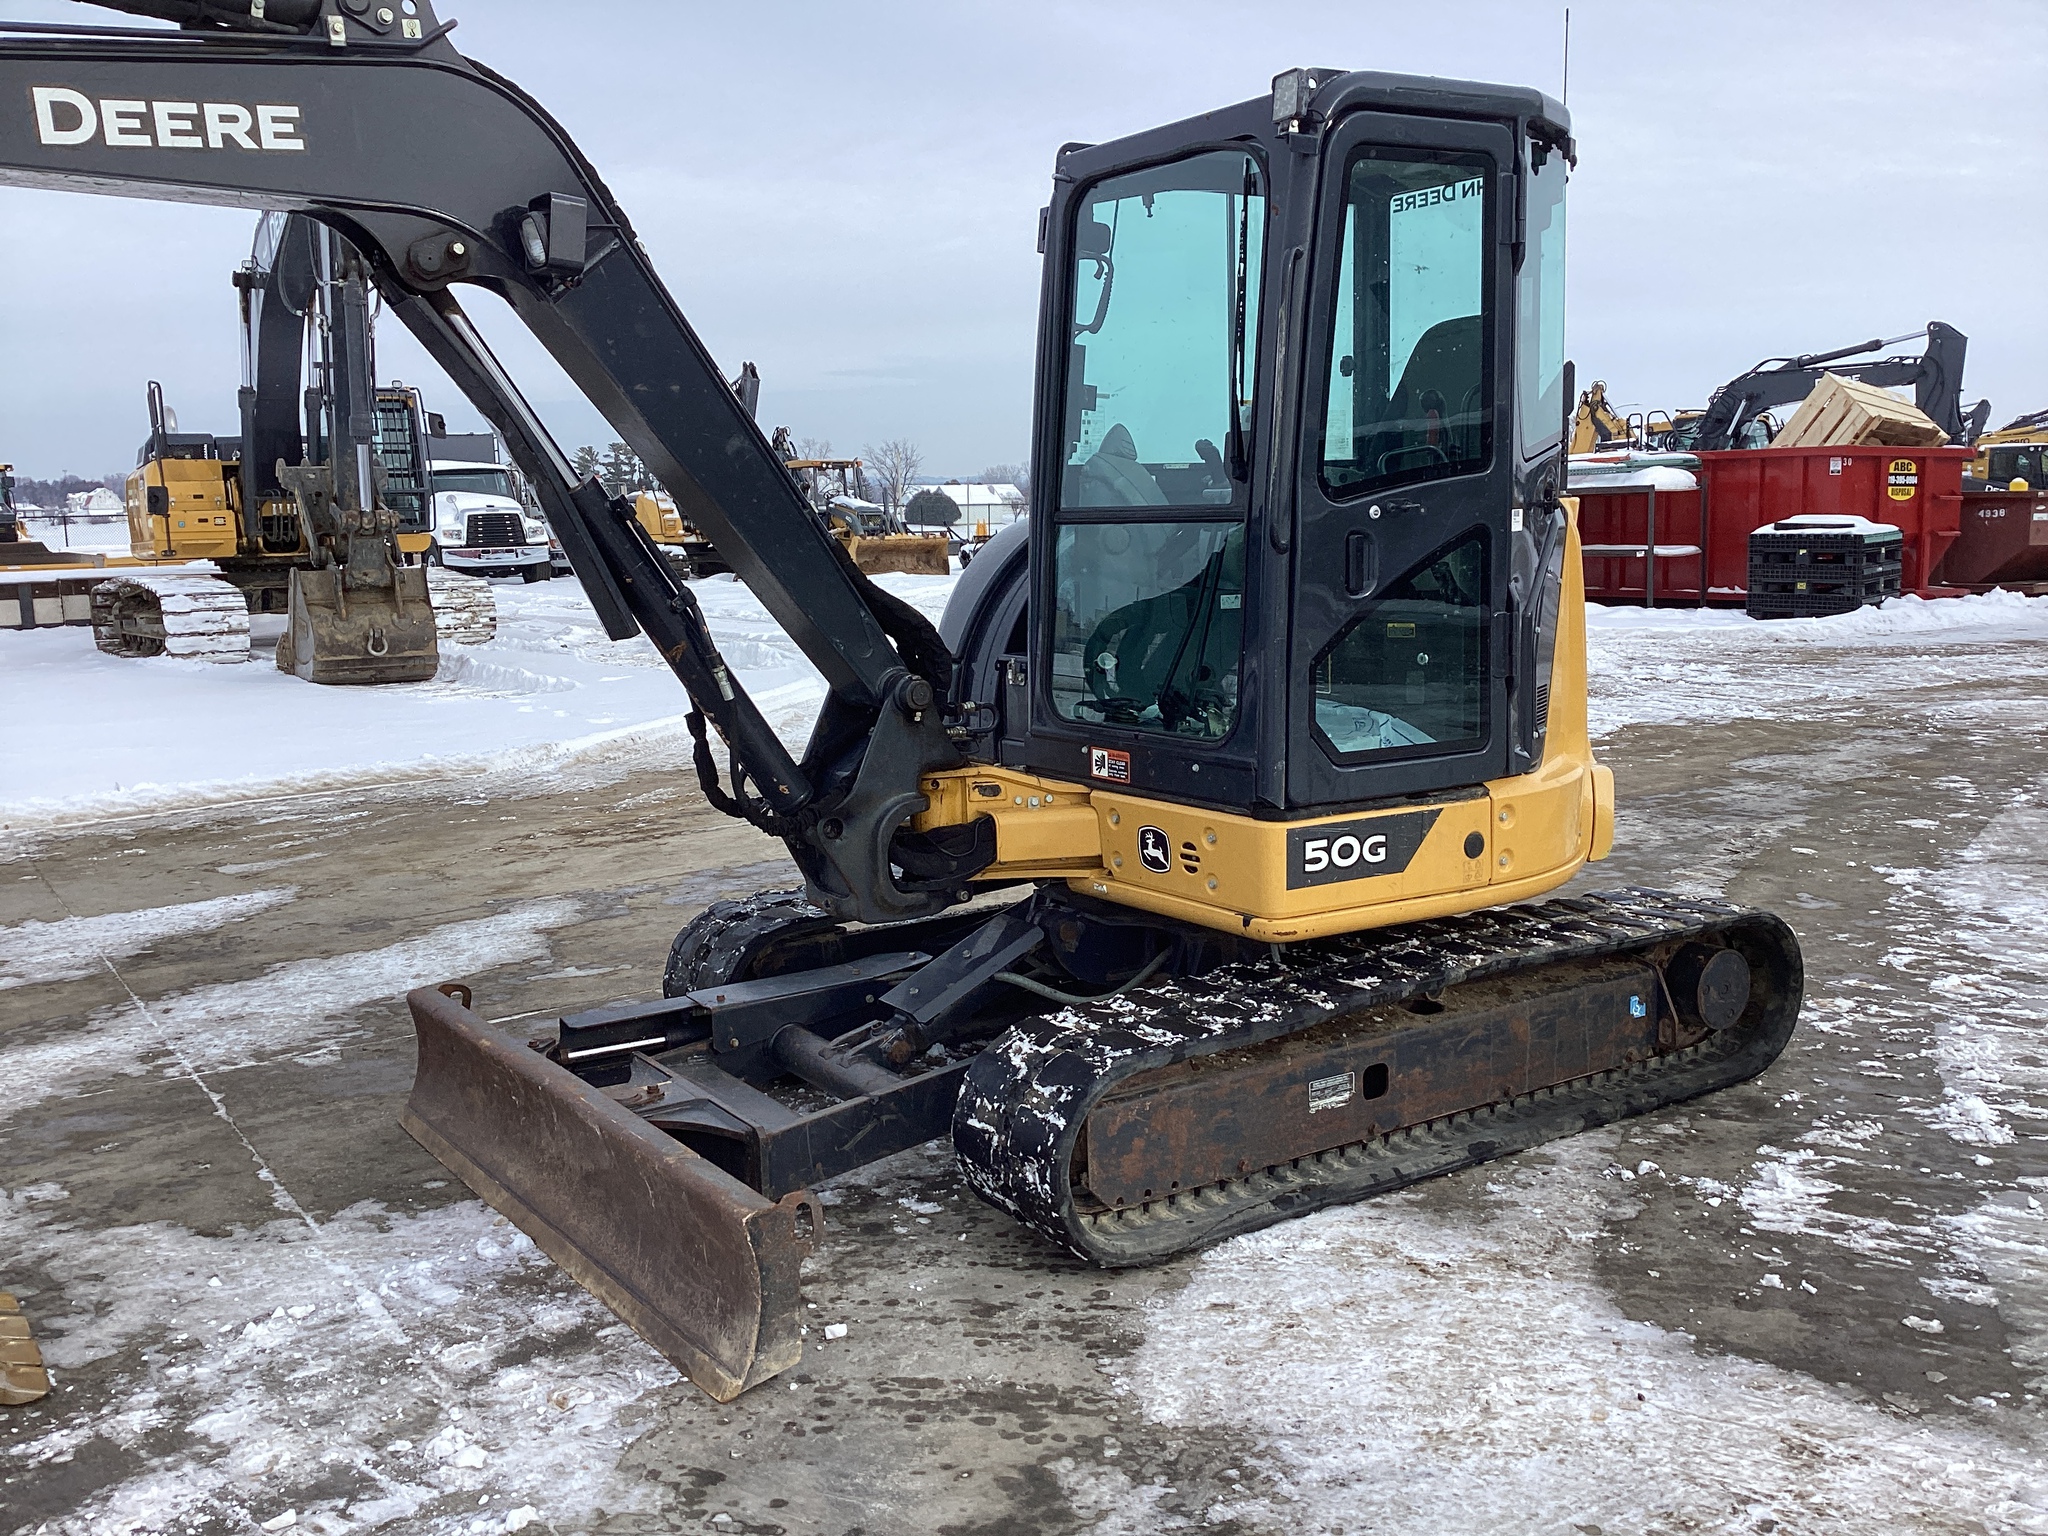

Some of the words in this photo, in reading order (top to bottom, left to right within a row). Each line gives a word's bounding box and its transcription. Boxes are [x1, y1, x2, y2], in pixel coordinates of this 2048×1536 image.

[32, 86, 305, 150] DEERE
[1843, 457, 1852, 466] 30
[1893, 461, 1912, 472] ABC
[1304, 834, 1386, 872] 50G
